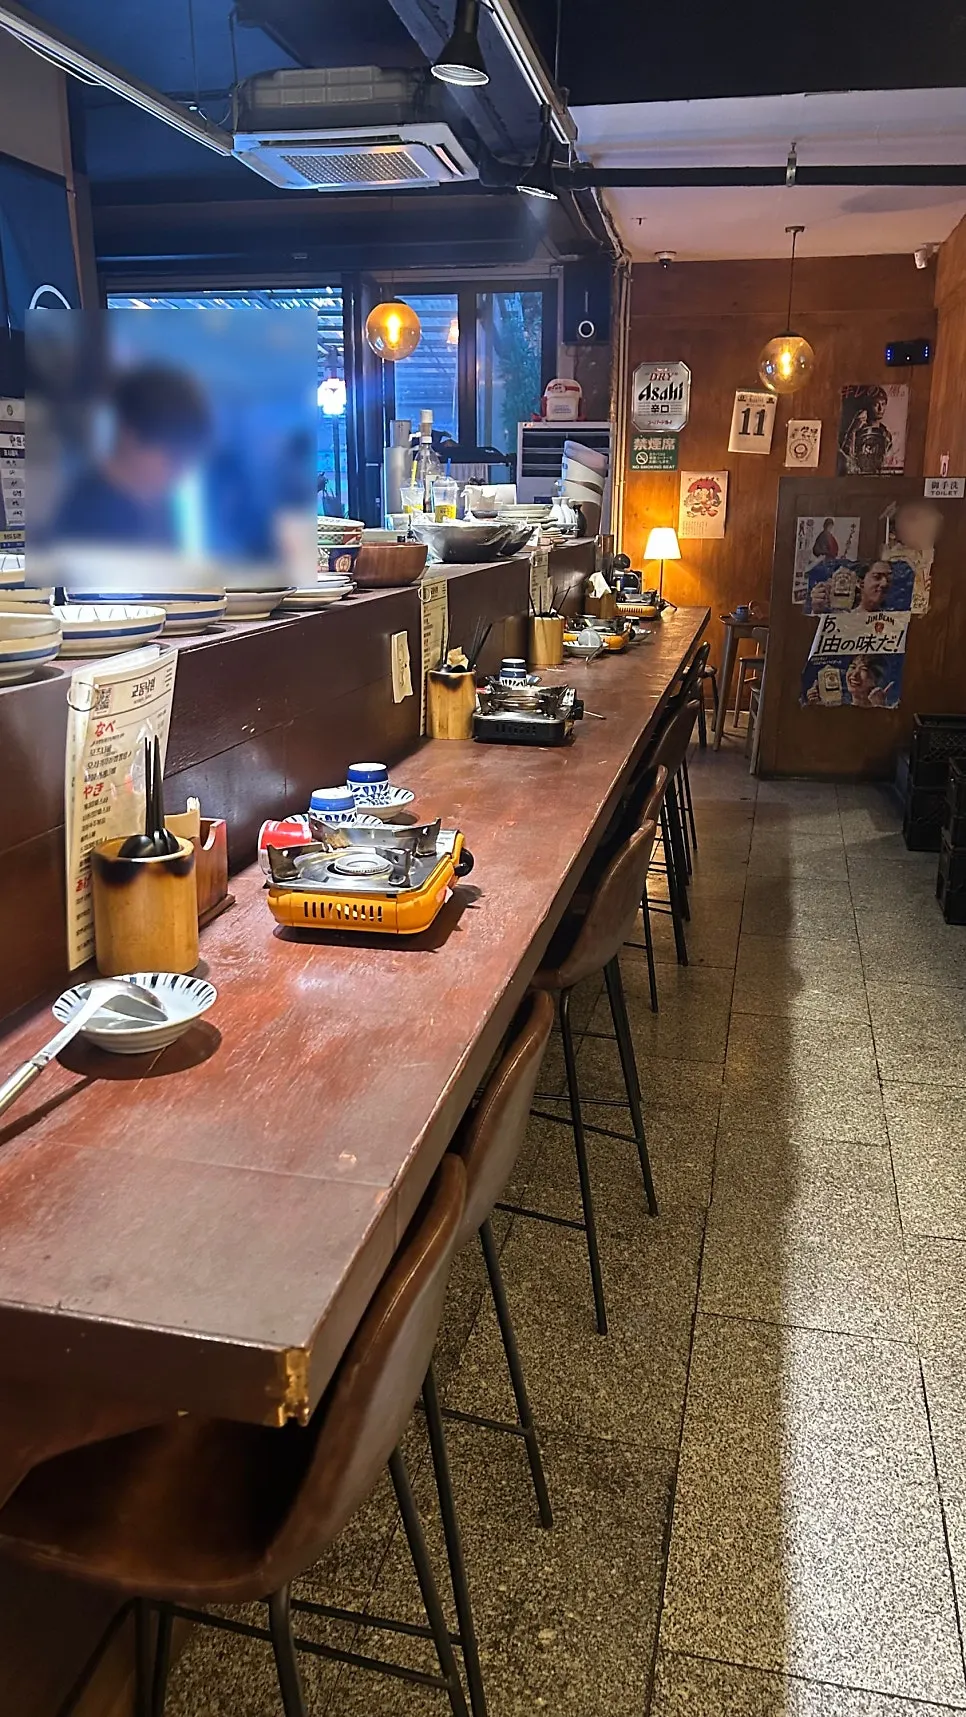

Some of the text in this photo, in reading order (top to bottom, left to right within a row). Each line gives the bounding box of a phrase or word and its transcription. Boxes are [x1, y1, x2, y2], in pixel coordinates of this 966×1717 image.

[638, 381, 684, 401] Asahi
[650, 404, 670, 413] 辛口
[738, 407, 766, 437] 11
[633, 437, 676, 451] 禁煙席
[865, 613, 895, 626] JIM BEAM
[94, 719, 117, 738] なべ
[83, 782, 105, 800] やき
